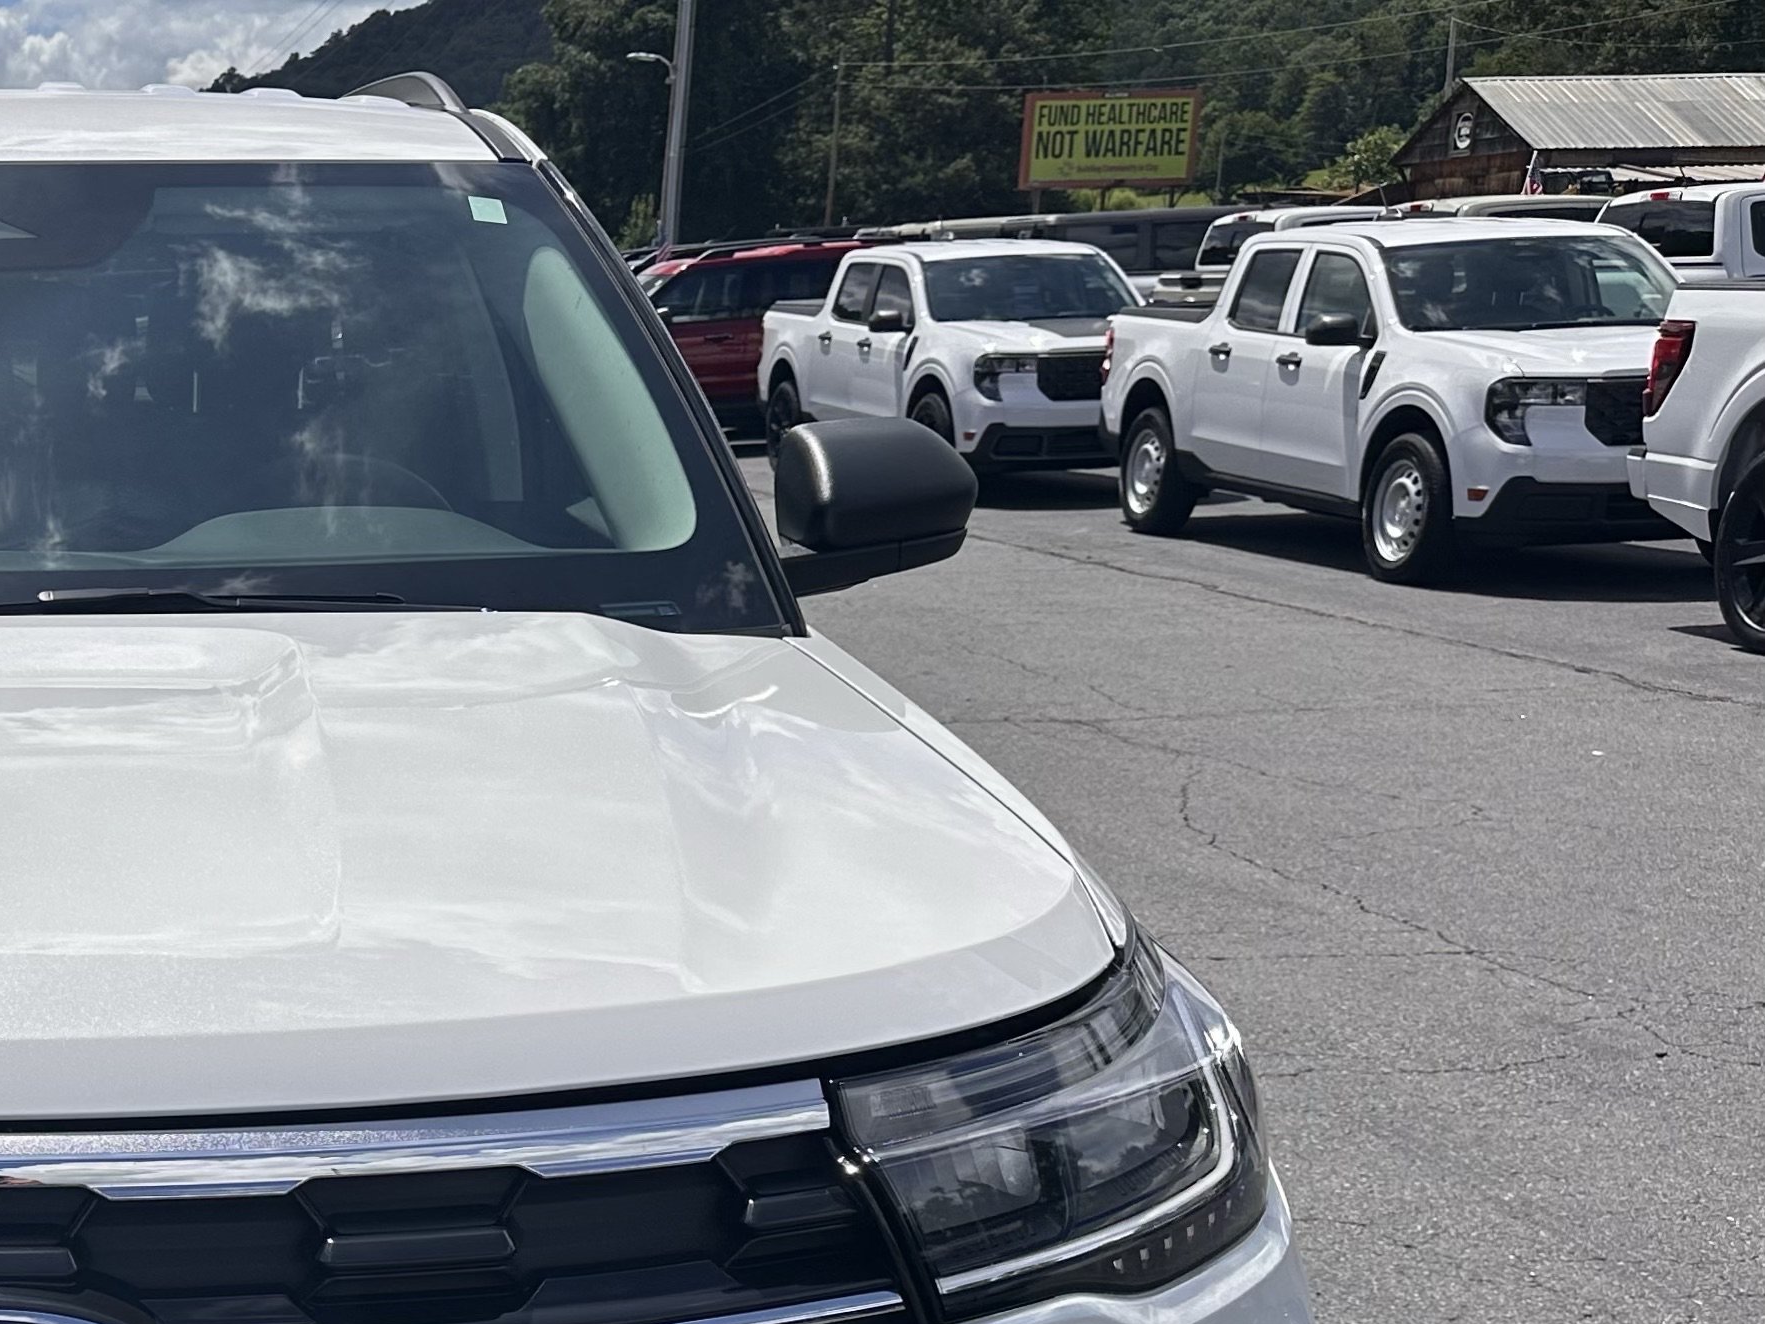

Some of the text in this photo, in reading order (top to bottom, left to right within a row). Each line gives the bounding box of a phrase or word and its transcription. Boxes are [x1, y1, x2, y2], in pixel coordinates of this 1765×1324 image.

[1038, 102, 1190, 126] FUND HEALTHCARE
[1035, 128, 1188, 159] NOT WARFARE
